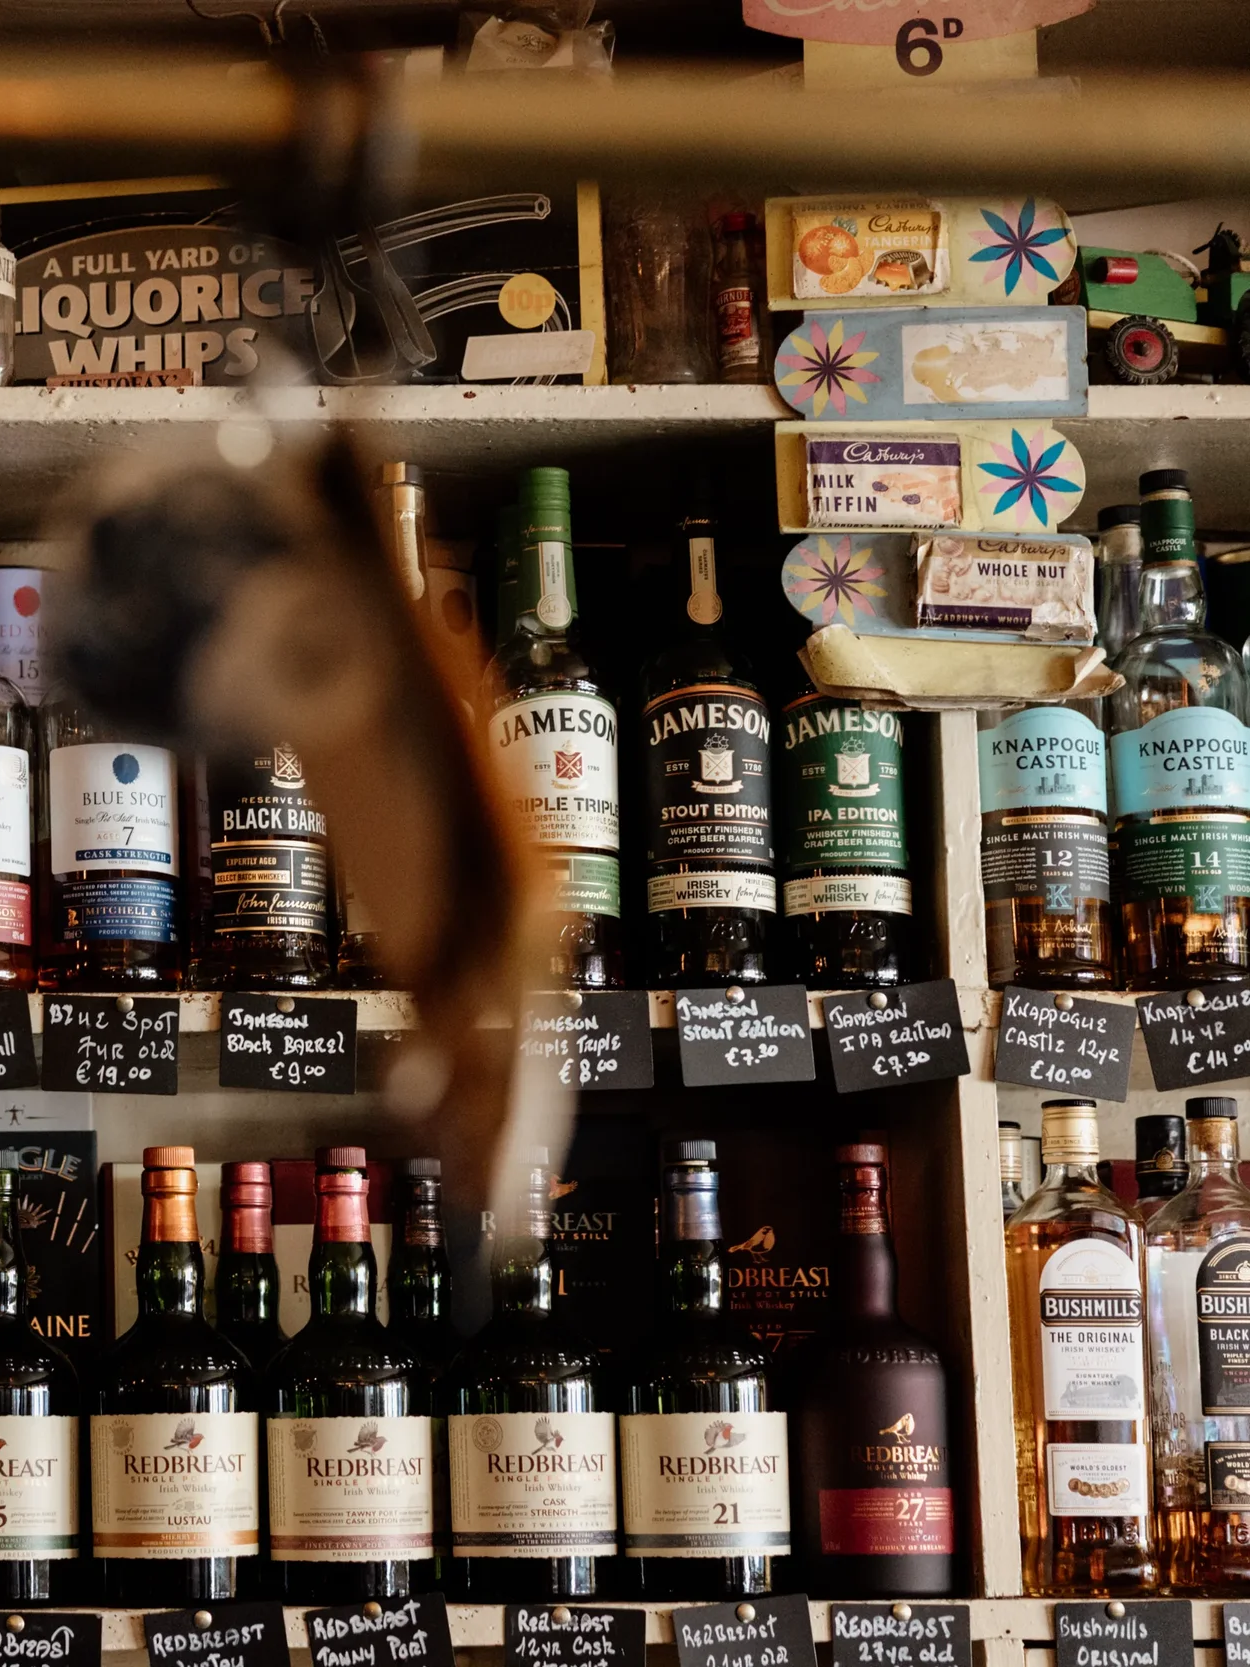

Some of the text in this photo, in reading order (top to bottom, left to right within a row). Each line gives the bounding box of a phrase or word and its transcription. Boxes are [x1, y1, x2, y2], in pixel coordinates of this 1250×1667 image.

[43, 243, 266, 278] A FULL YARD OF
[49, 329, 259, 377] WHIPS
[843, 442, 925, 464] Cadbury's
[812, 473, 855, 489] MILK
[812, 496, 878, 513] TIFFIN
[977, 562, 1066, 580] WHOLE NUT
[500, 708, 616, 748] JAMESON
[650, 703, 770, 746] JAMESON
[785, 707, 904, 750] JAMESON
[992, 737, 1100, 756] KNAPPOGUE
[1139, 738, 1248, 758] KNAPPOGUE
[744, 763, 762, 772] 1780
[1016, 755, 1087, 771] CASTLE
[1163, 756, 1235, 772] CASTLE
[82, 792, 167, 808] BLUE SPOT
[574, 798, 620, 818] TRIPLE
[223, 808, 282, 831] BLACK
[661, 804, 768, 820] STOUT EDITION
[808, 807, 898, 823] IPA EDITION
[122, 826, 134, 846] 7
[670, 826, 712, 836] WHISKEY
[715, 826, 753, 835] FINISHED
[806, 830, 850, 840] WHISKEY
[852, 829, 890, 838] FINISHED
[986, 831, 1080, 845] SINGLE MALT IRISH
[1134, 832, 1228, 846] SINGLE MALT IRISH
[668, 834, 764, 845] CRAFT BEER BARRELS
[804, 838, 902, 849] CRAFT BEER BARRELS
[84, 850, 167, 862] CASK STRENGTH
[226, 856, 277, 866] EXPERTLY AGED
[1042, 850, 1073, 867] 12
[1190, 851, 1221, 868] 14
[687, 880, 719, 890] IRISH
[824, 884, 857, 894] IRISH
[676, 889, 731, 900] WHISKEY
[814, 892, 869, 904] WHISKEY
[267, 916, 314, 927] IRISH WHISKEY
[839, 1035, 884, 1052] IPA
[1045, 1298, 1140, 1317] BUSHMILLS
[1050, 1332, 1135, 1344] THE ORIGINAL
[124, 1453, 244, 1475] REDBREAST
[307, 1456, 423, 1478] REDBREAST
[487, 1453, 606, 1475] REDBREAST
[659, 1455, 779, 1477] REDBREAST
[543, 1497, 567, 1507] CASK
[895, 1498, 924, 1521] 27
[168, 1515, 212, 1527] LUSTAU
[345, 1511, 376, 1519] TAWNY
[378, 1509, 398, 1518] PORT
[345, 1517, 364, 1526] CASK
[366, 1516, 398, 1525] EDITION
[530, 1508, 578, 1518] STRENGTH
[713, 1502, 741, 1525] 21
